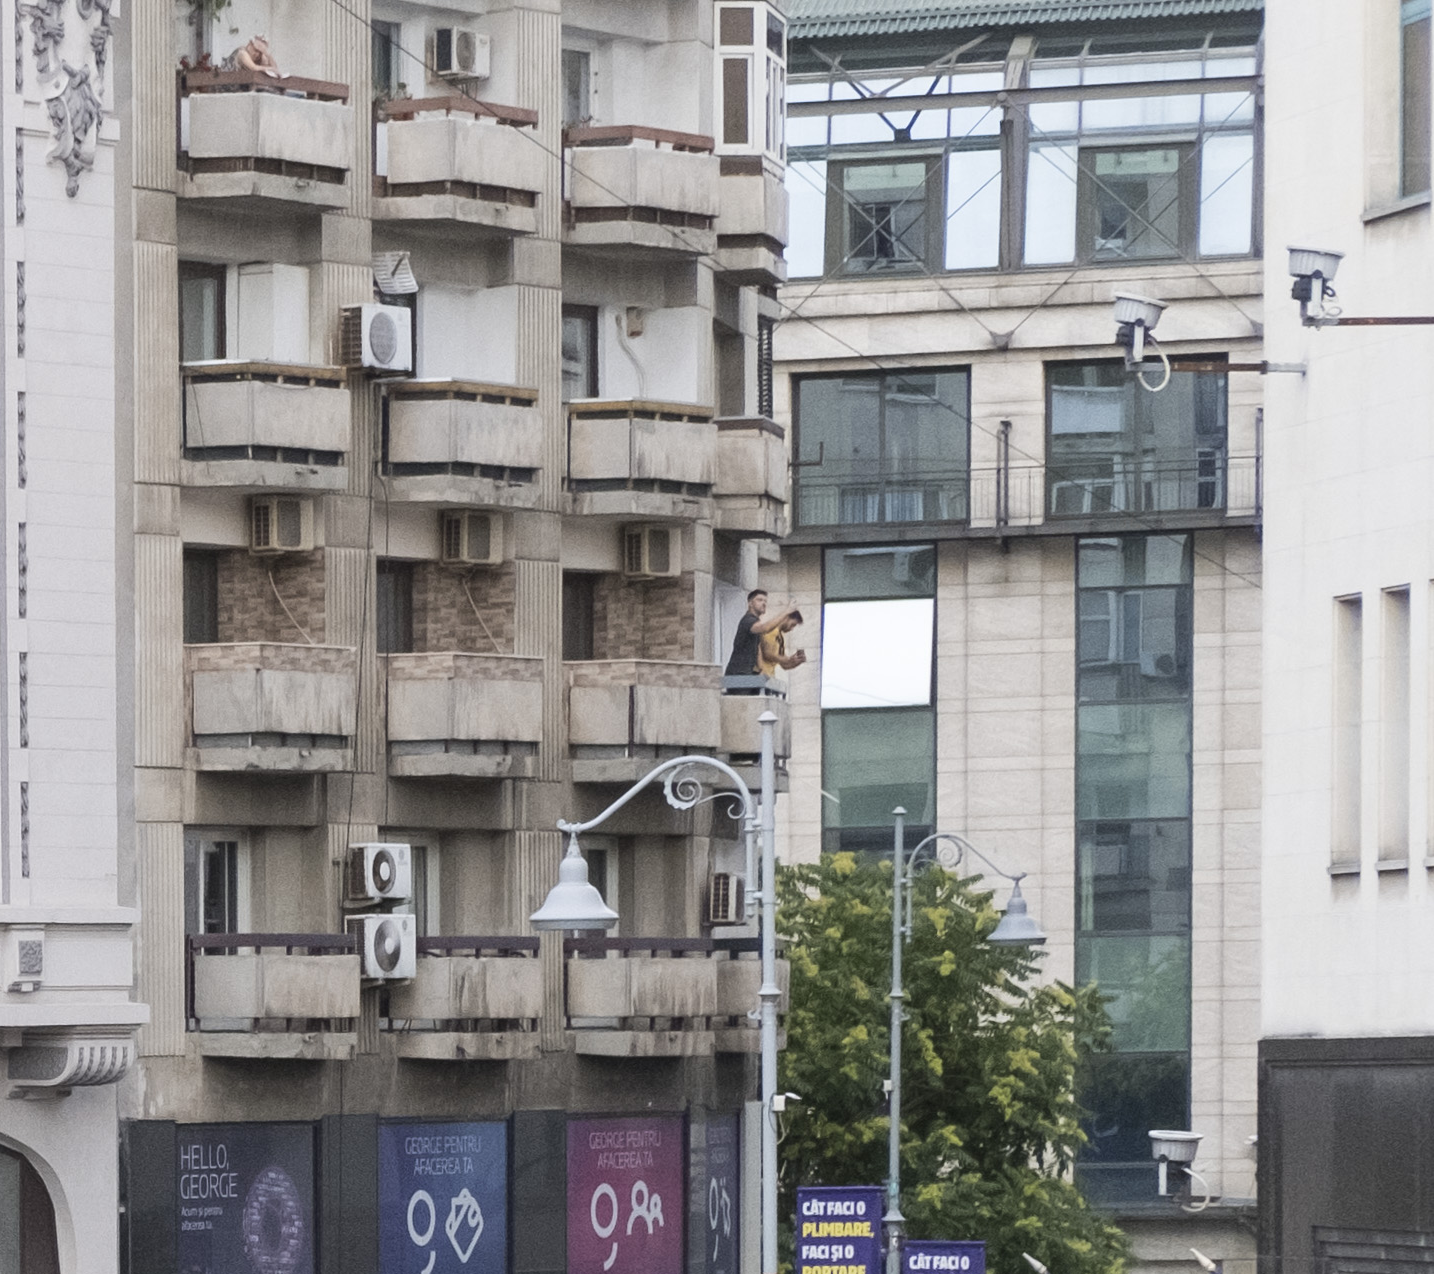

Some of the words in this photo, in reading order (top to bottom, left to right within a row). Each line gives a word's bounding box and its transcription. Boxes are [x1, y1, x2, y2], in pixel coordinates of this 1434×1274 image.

[180, 1143, 230, 1171] HELLO,
[405, 1136, 443, 1155] GEORGE
[445, 1135, 481, 1153] PENTRU
[180, 1173, 238, 1199] GEORGE
